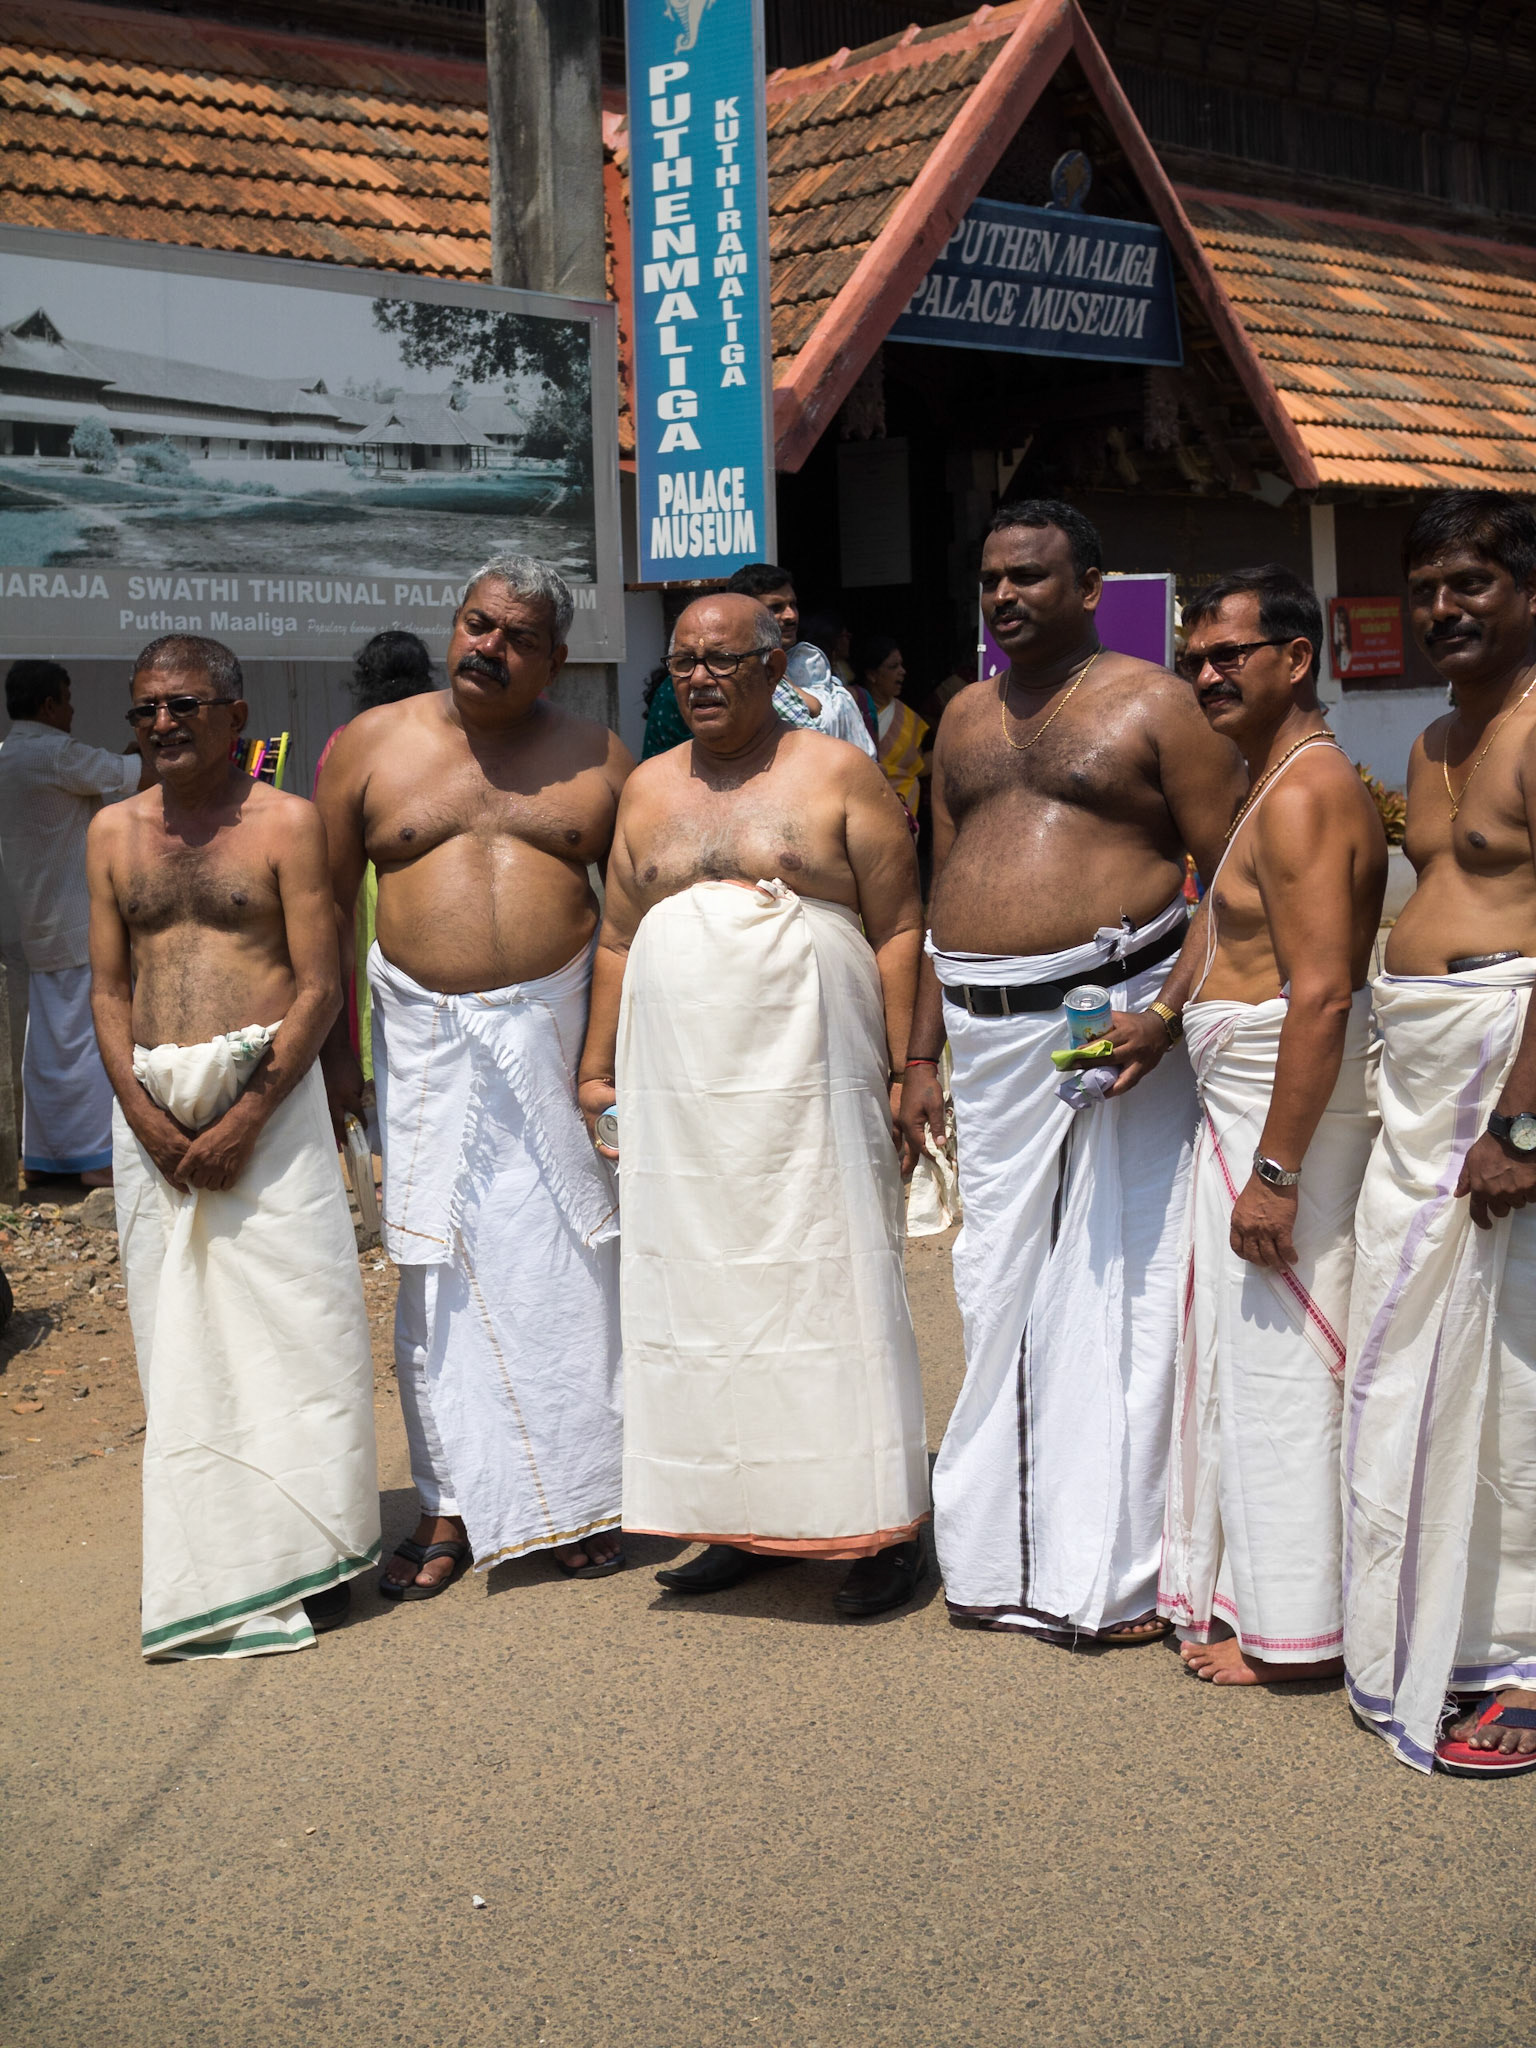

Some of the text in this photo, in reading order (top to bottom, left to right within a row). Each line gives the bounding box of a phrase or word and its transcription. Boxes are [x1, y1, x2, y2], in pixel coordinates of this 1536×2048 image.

[713, 96, 748, 388] KUTHIRAMALIGA
[1057, 233, 1158, 287] MALIGA
[1019, 286, 1152, 339] MUSEUM
[658, 466, 746, 516] PALACE
[650, 510, 757, 560] MUSEUM
[0, 572, 110, 600] ARAJA
[127, 575, 240, 602] SWATHI
[248, 579, 387, 606] THIRUNAL
[119, 609, 201, 631] Puthan
[210, 611, 298, 637] Maaliga
